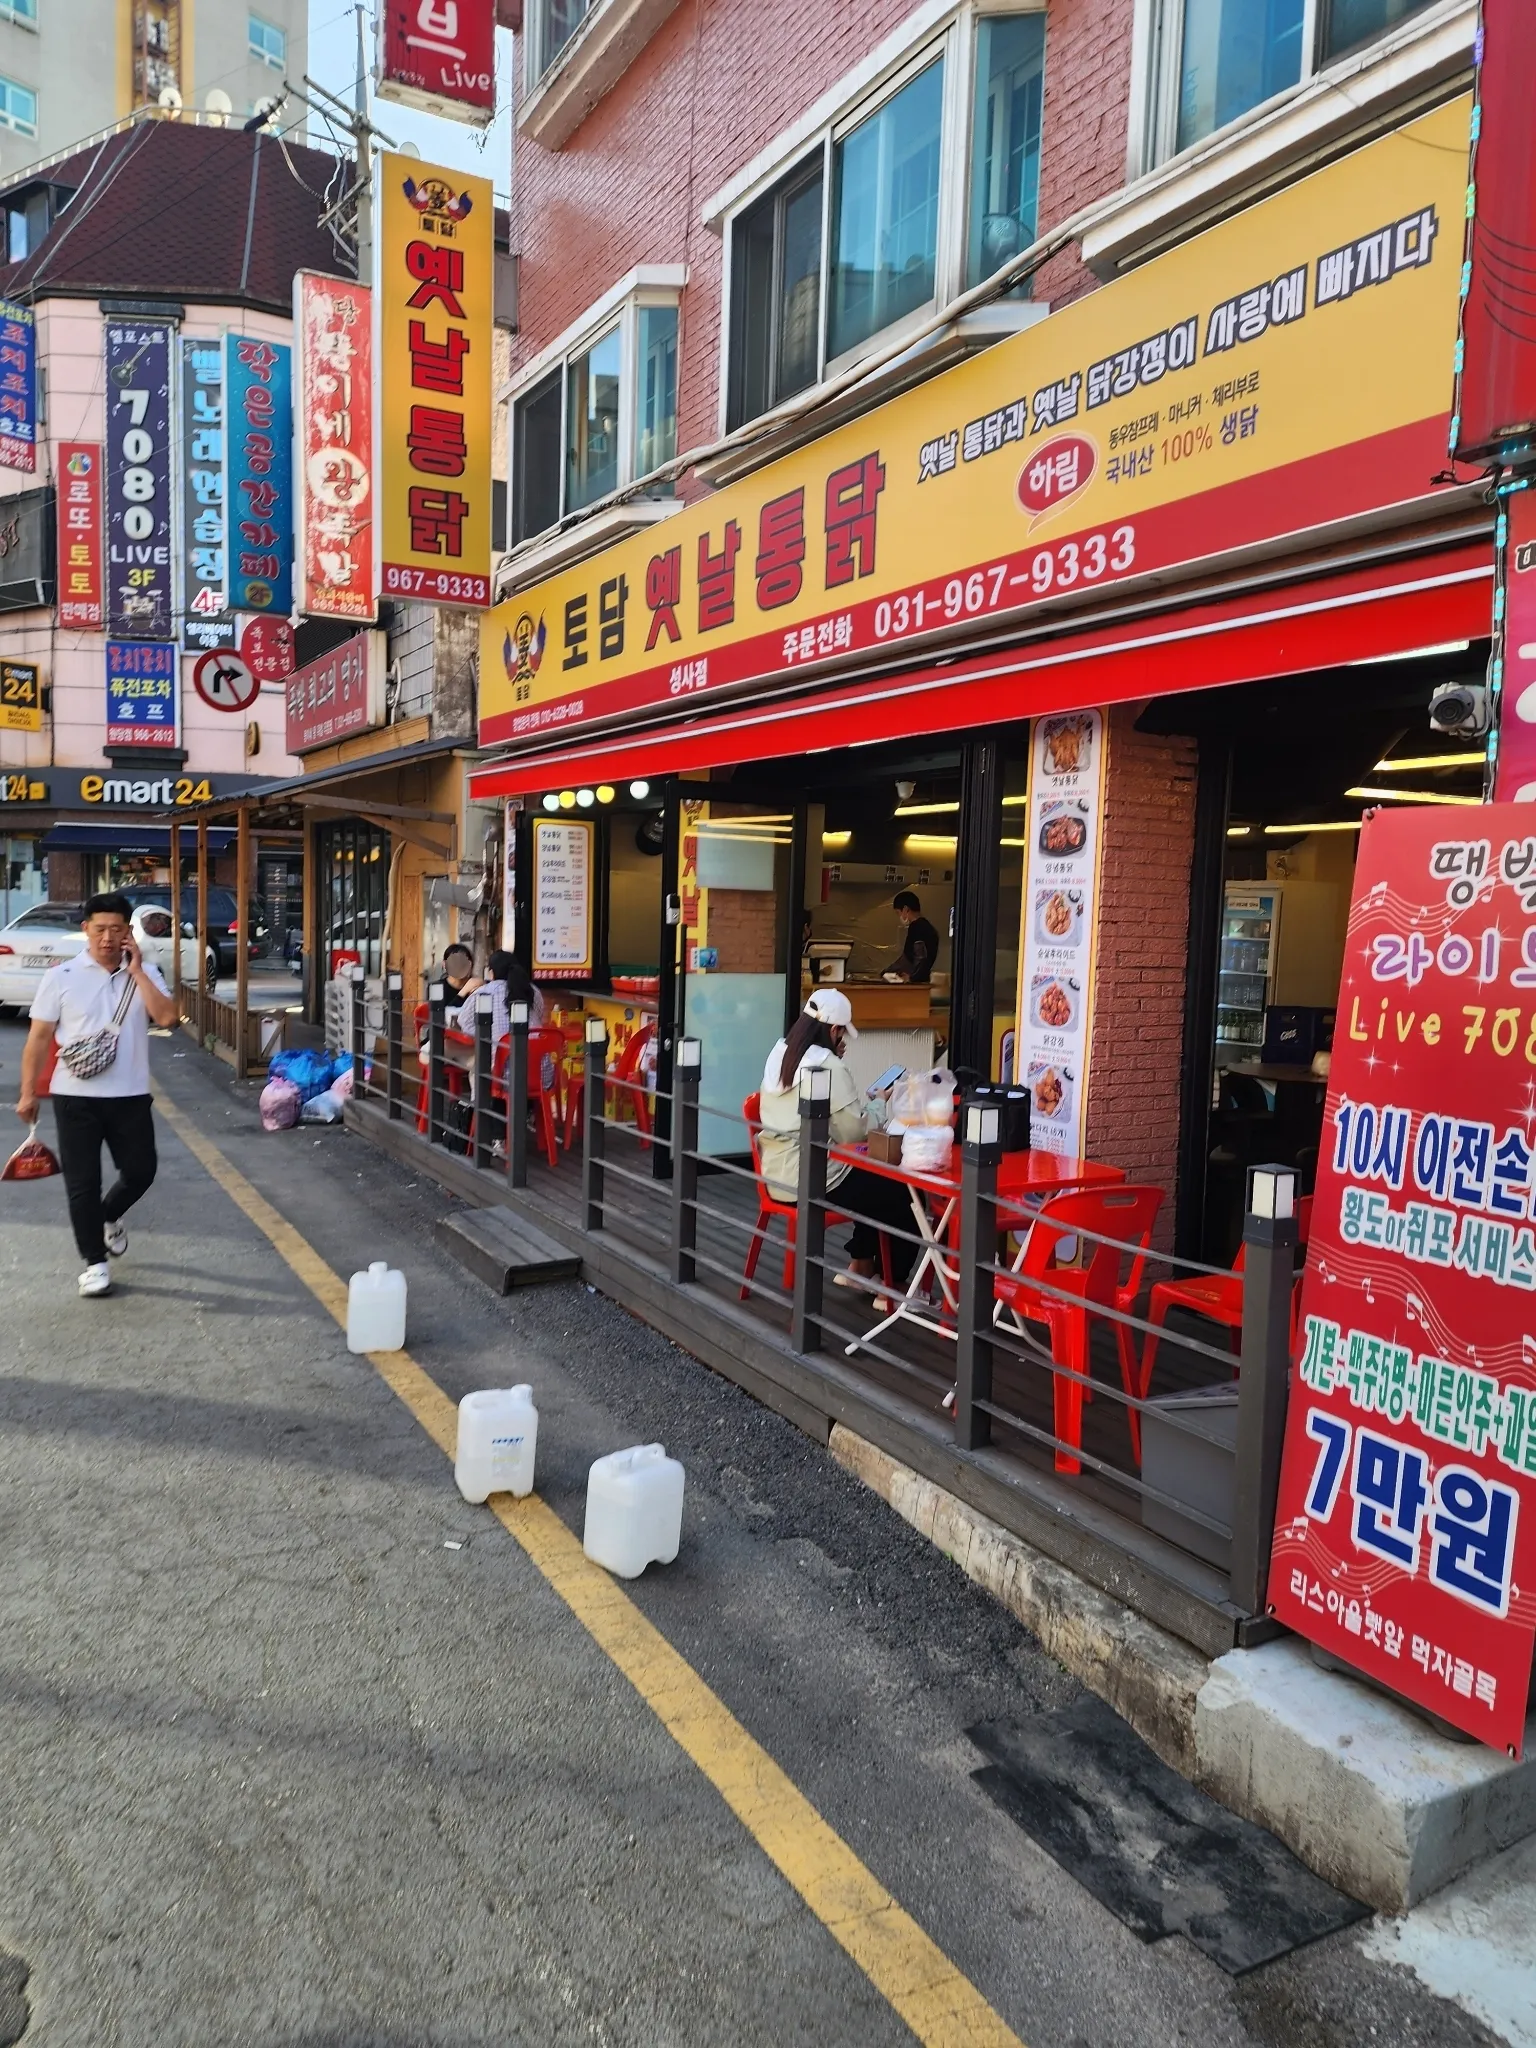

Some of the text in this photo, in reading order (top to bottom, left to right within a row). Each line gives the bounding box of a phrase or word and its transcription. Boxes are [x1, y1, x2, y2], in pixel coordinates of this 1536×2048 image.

[441, 62, 491, 91] Live
[917, 203, 1439, 484] 옛날 통닭과 옛날 닭강정이 사랑에 빠지다
[405, 240, 470, 557] 옛날통닭
[1109, 369, 1261, 450] 동우참프레 마니커 체리부로
[119, 389, 156, 540] 7080
[1029, 446, 1080, 497] 하림
[1105, 403, 1260, 485] 국내산 100% 생닭
[66, 480, 93, 594] 로또 토토
[110, 545, 169, 565] LIVE
[562, 449, 887, 673] 토담 옛날통닭
[61, 602, 101, 621] 판매점
[128, 568, 156, 587] 3F
[387, 567, 486, 600] 967-9333
[782, 525, 1136, 664] 주문전화 031-967-9333
[4, 677, 36, 703] 24
[110, 678, 171, 699] 퓨전포차
[669, 658, 708, 694] 성사점
[80, 775, 213, 806] emart24
[1350, 996, 1441, 1046] Live
[1334, 1102, 1536, 1222] 10시 이전손
[1455, 1215, 1536, 1291] 서비스
[1306, 1408, 1520, 1620] 7만원
[1411, 1634, 1498, 1711] 먹자골목
